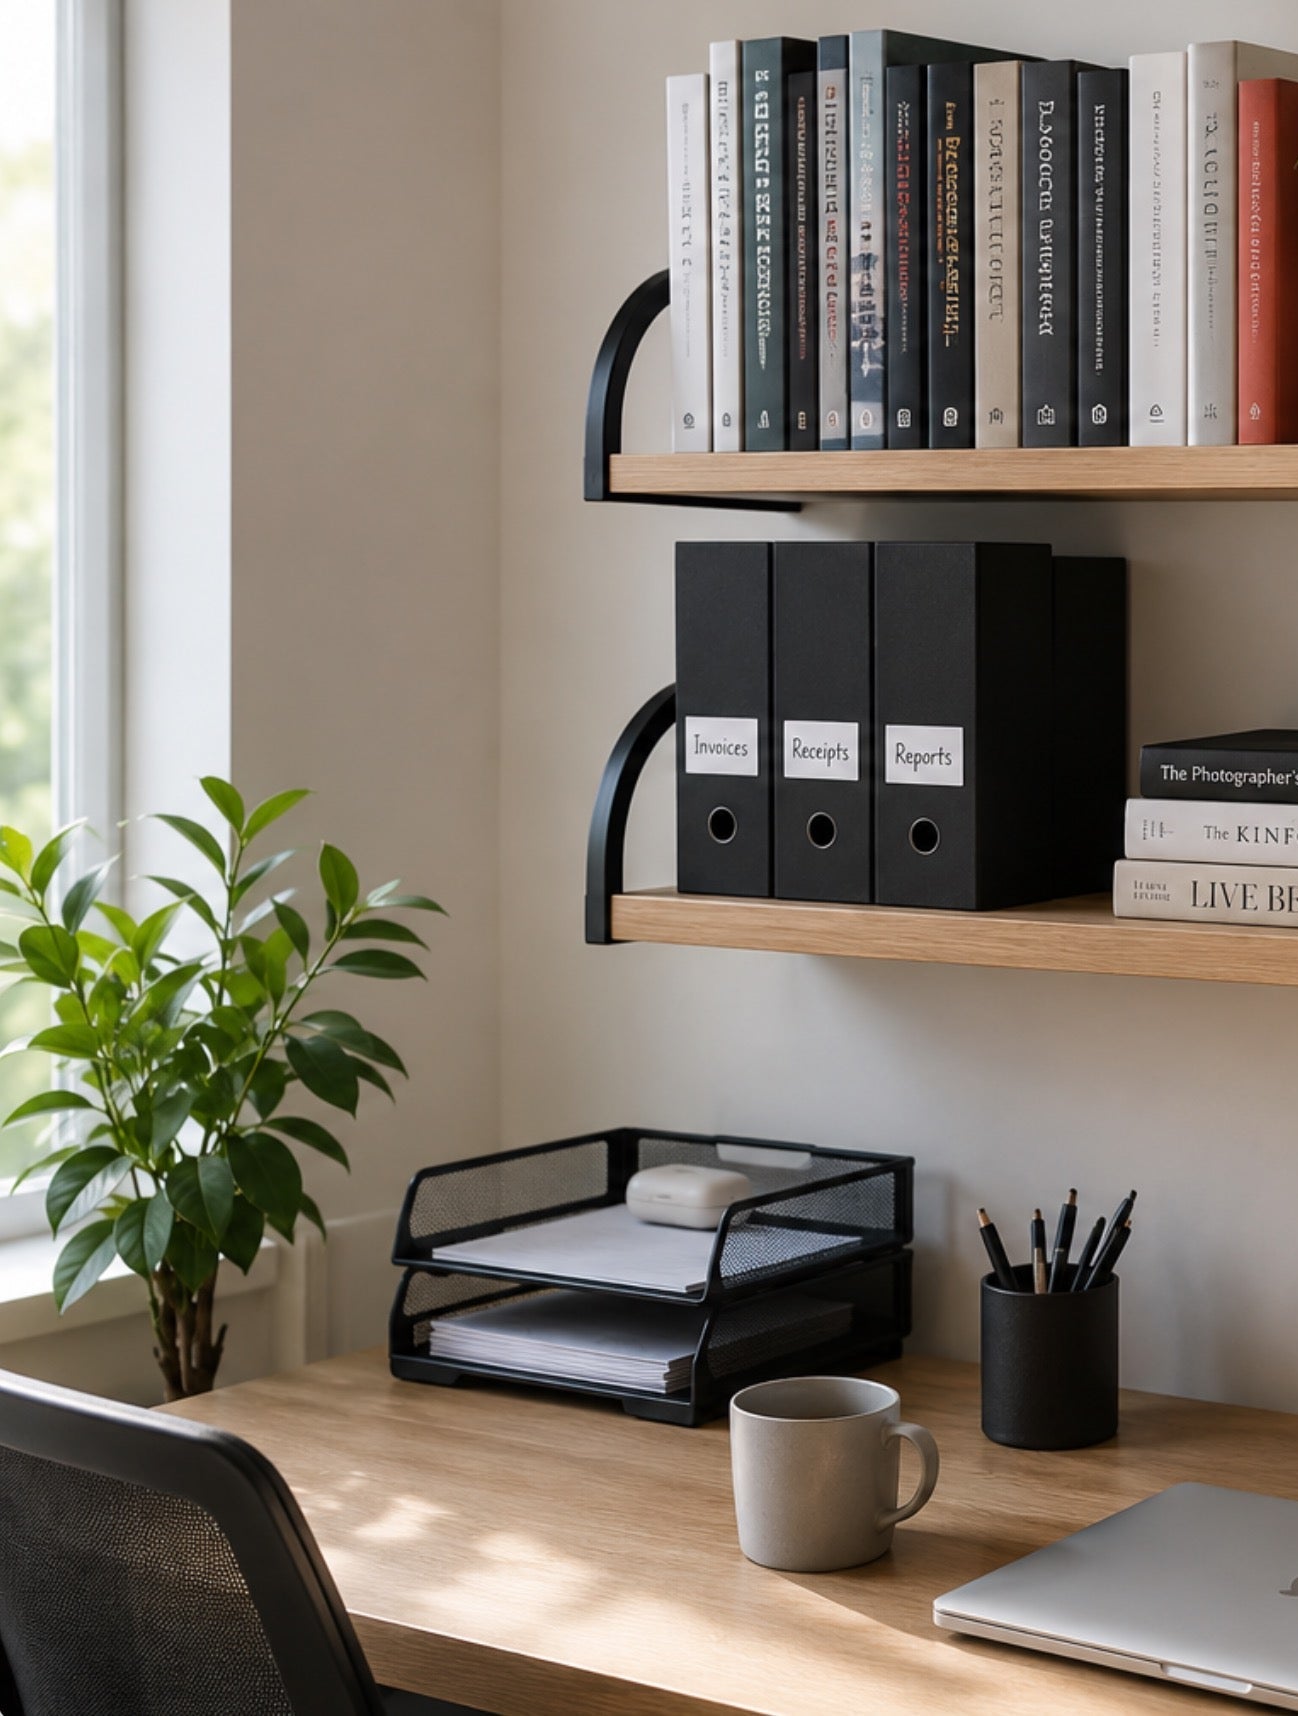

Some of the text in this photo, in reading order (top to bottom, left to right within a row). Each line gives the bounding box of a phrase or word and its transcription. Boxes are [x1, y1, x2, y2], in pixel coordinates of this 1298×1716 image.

[693, 733, 749, 757] Invoices
[792, 737, 850, 767] Receipts
[895, 742, 953, 773] Reports
[1160, 764, 1188, 782] The
[1203, 825, 1230, 841] The
[1190, 880, 1259, 912] LIVE
